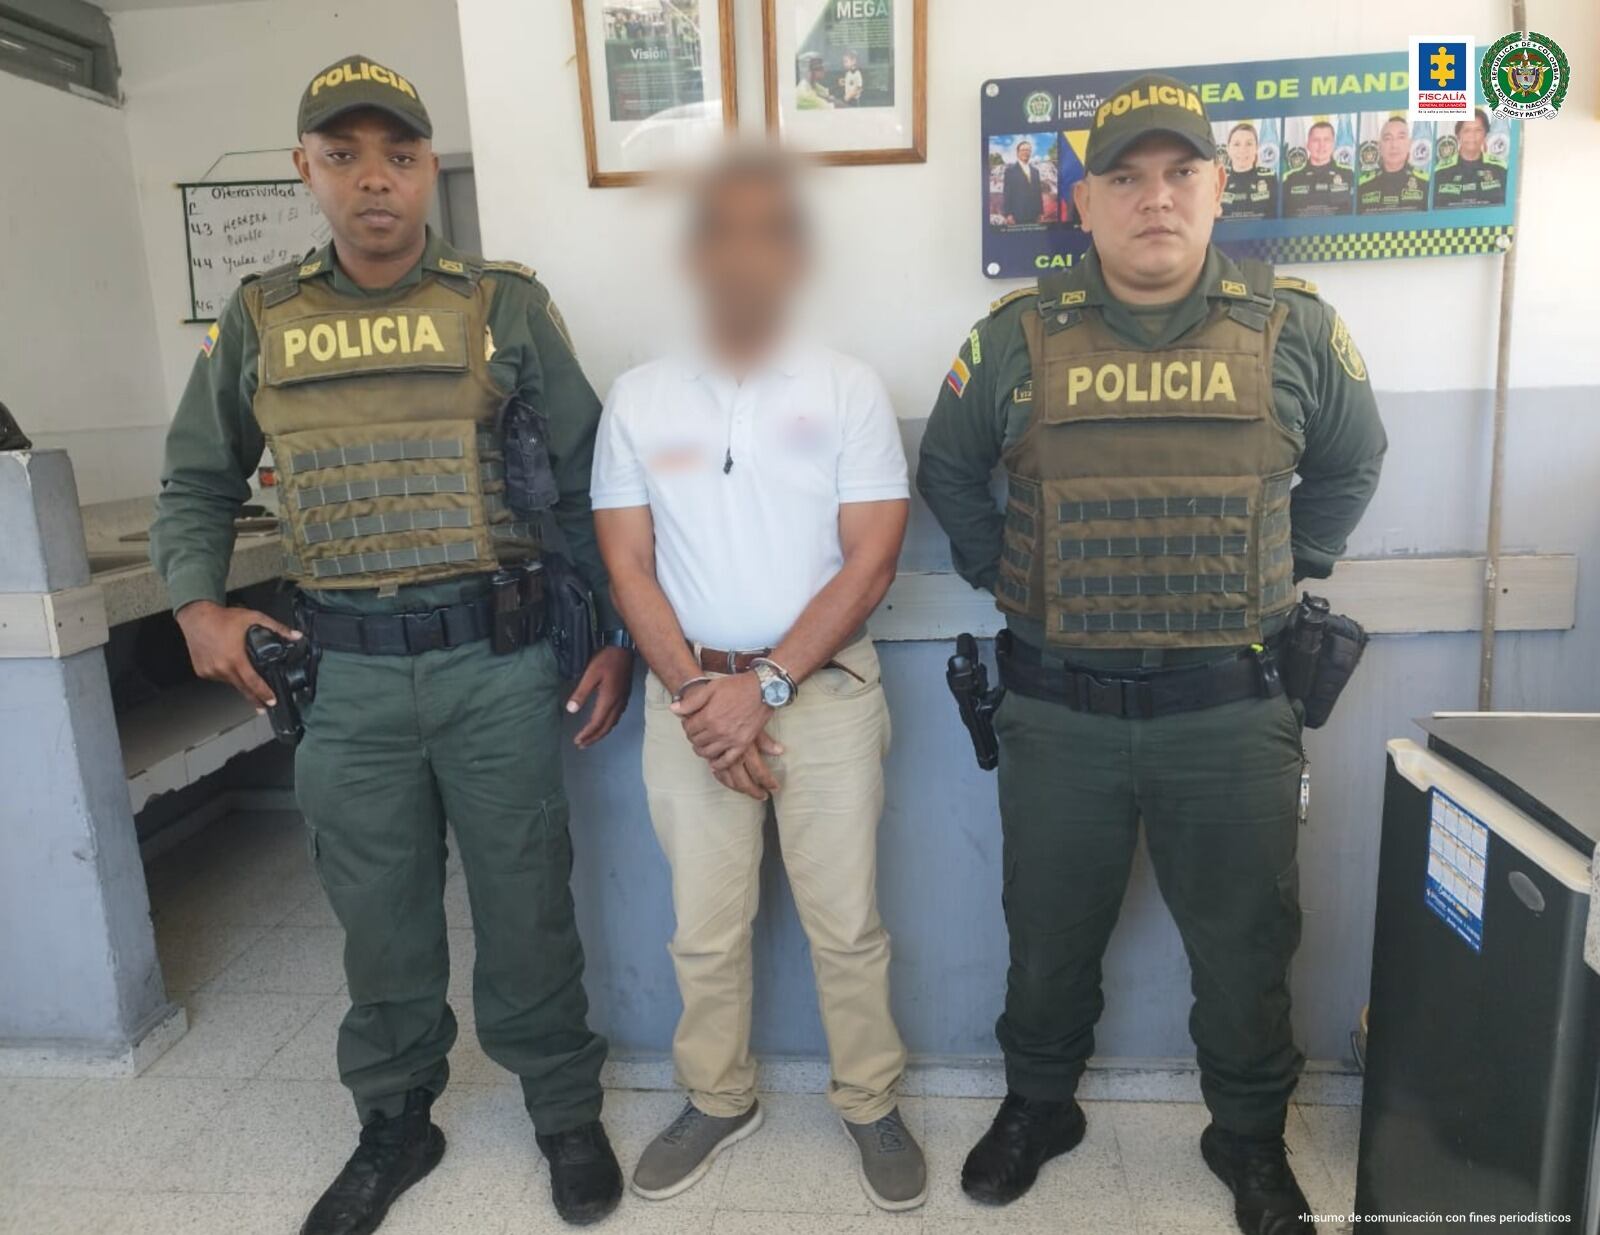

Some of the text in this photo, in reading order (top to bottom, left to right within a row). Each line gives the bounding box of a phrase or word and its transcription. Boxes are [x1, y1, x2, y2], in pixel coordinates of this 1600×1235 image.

[837, 0, 888, 19] MEGA
[630, 46, 668, 60] Visión
[311, 62, 417, 99] POLICIA
[1256, 78, 1299, 101] DE
[1311, 71, 1409, 97] MAND
[1063, 99, 1102, 110] HONO
[1096, 85, 1203, 128] POLICIA
[211, 184, 296, 200] Operatividad
[1034, 253, 1072, 269] CAI
[283, 315, 445, 368] POLICIA
[1067, 361, 1237, 405] POLICIA
